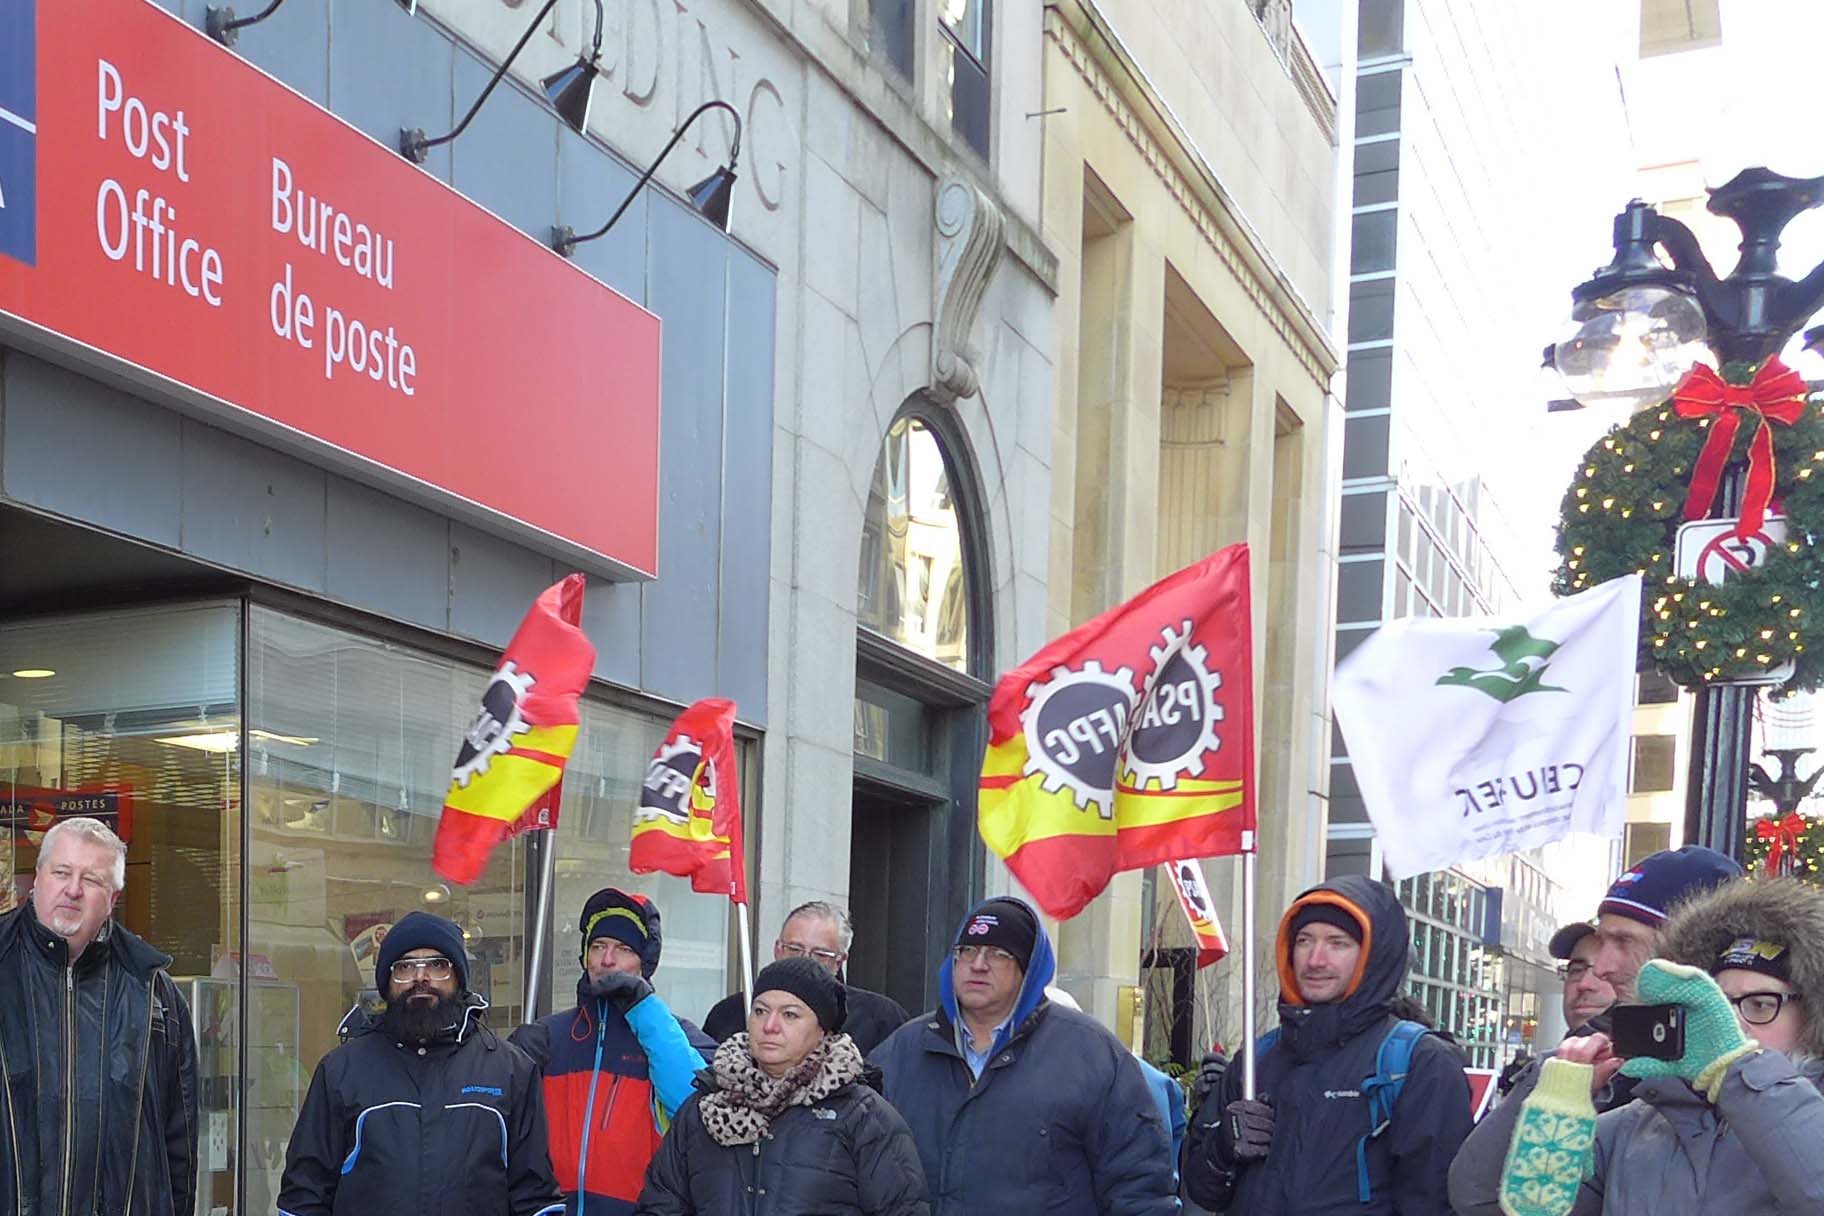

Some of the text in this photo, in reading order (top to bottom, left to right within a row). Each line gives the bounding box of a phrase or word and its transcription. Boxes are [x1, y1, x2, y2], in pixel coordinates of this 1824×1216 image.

[98, 58, 190, 183] Post
[96, 178, 224, 307] Office
[271, 157, 394, 290] Bureau
[270, 263, 416, 396] de poste
[60, 799, 106, 811] POSTES
